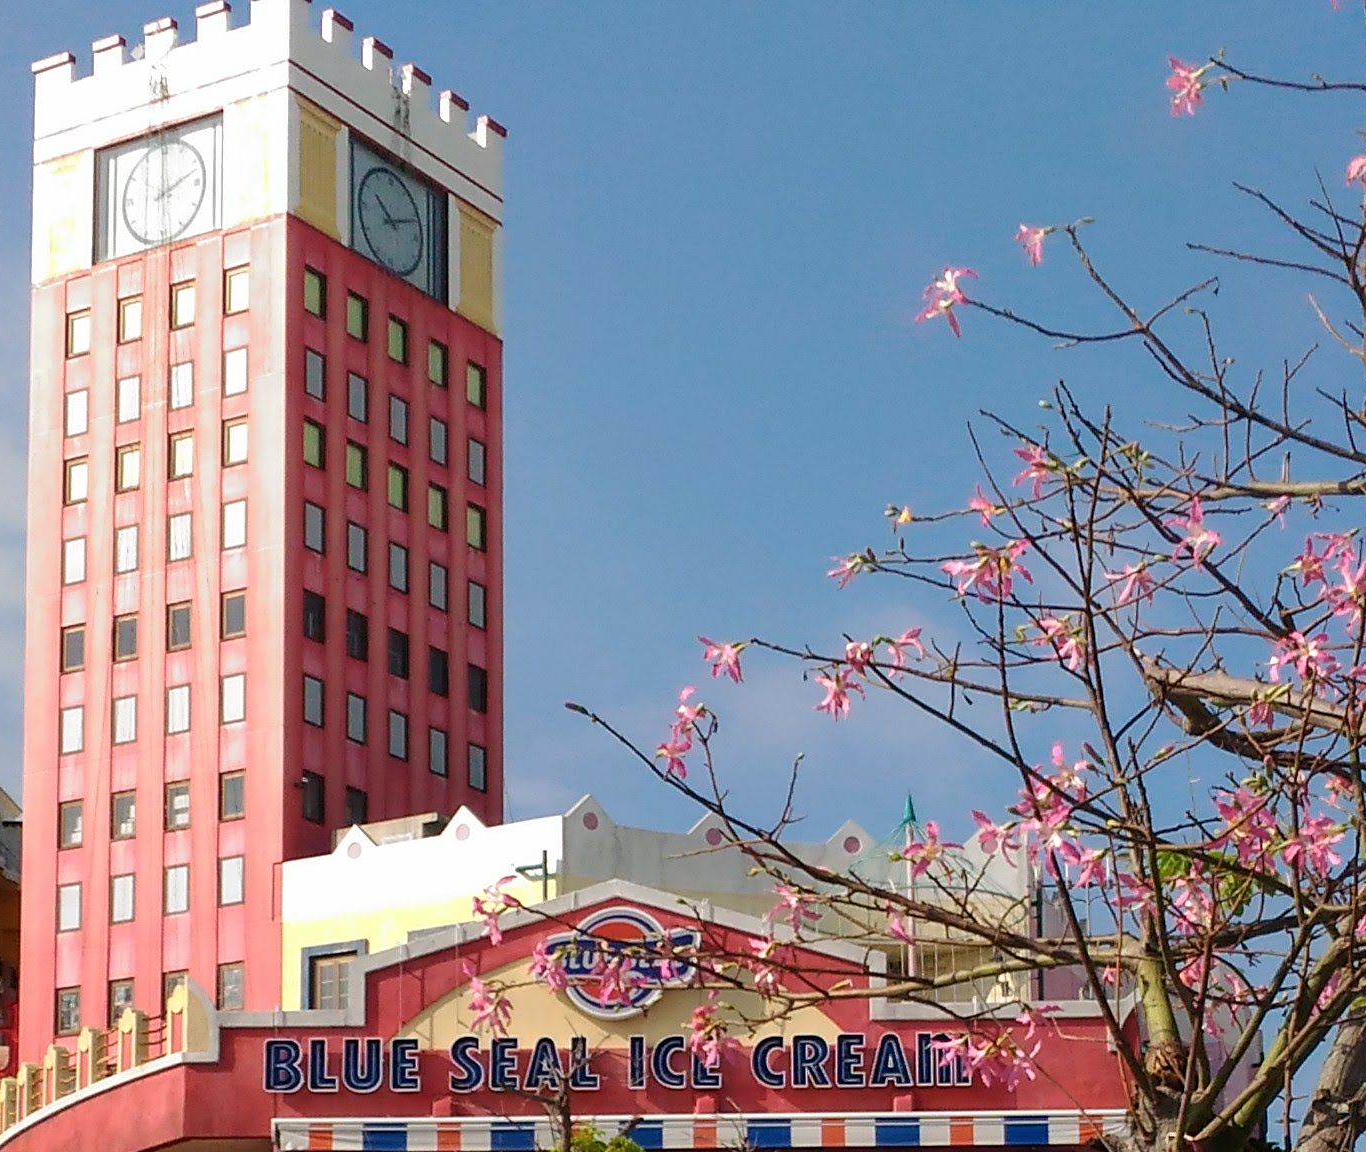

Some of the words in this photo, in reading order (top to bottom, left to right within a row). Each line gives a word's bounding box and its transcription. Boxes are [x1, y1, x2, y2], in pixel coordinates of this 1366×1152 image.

[263, 1038, 422, 1093] BLUE
[448, 1036, 600, 1093] SEAL
[628, 1034, 723, 1090] ICE
[750, 1031, 973, 1089] CREAM
